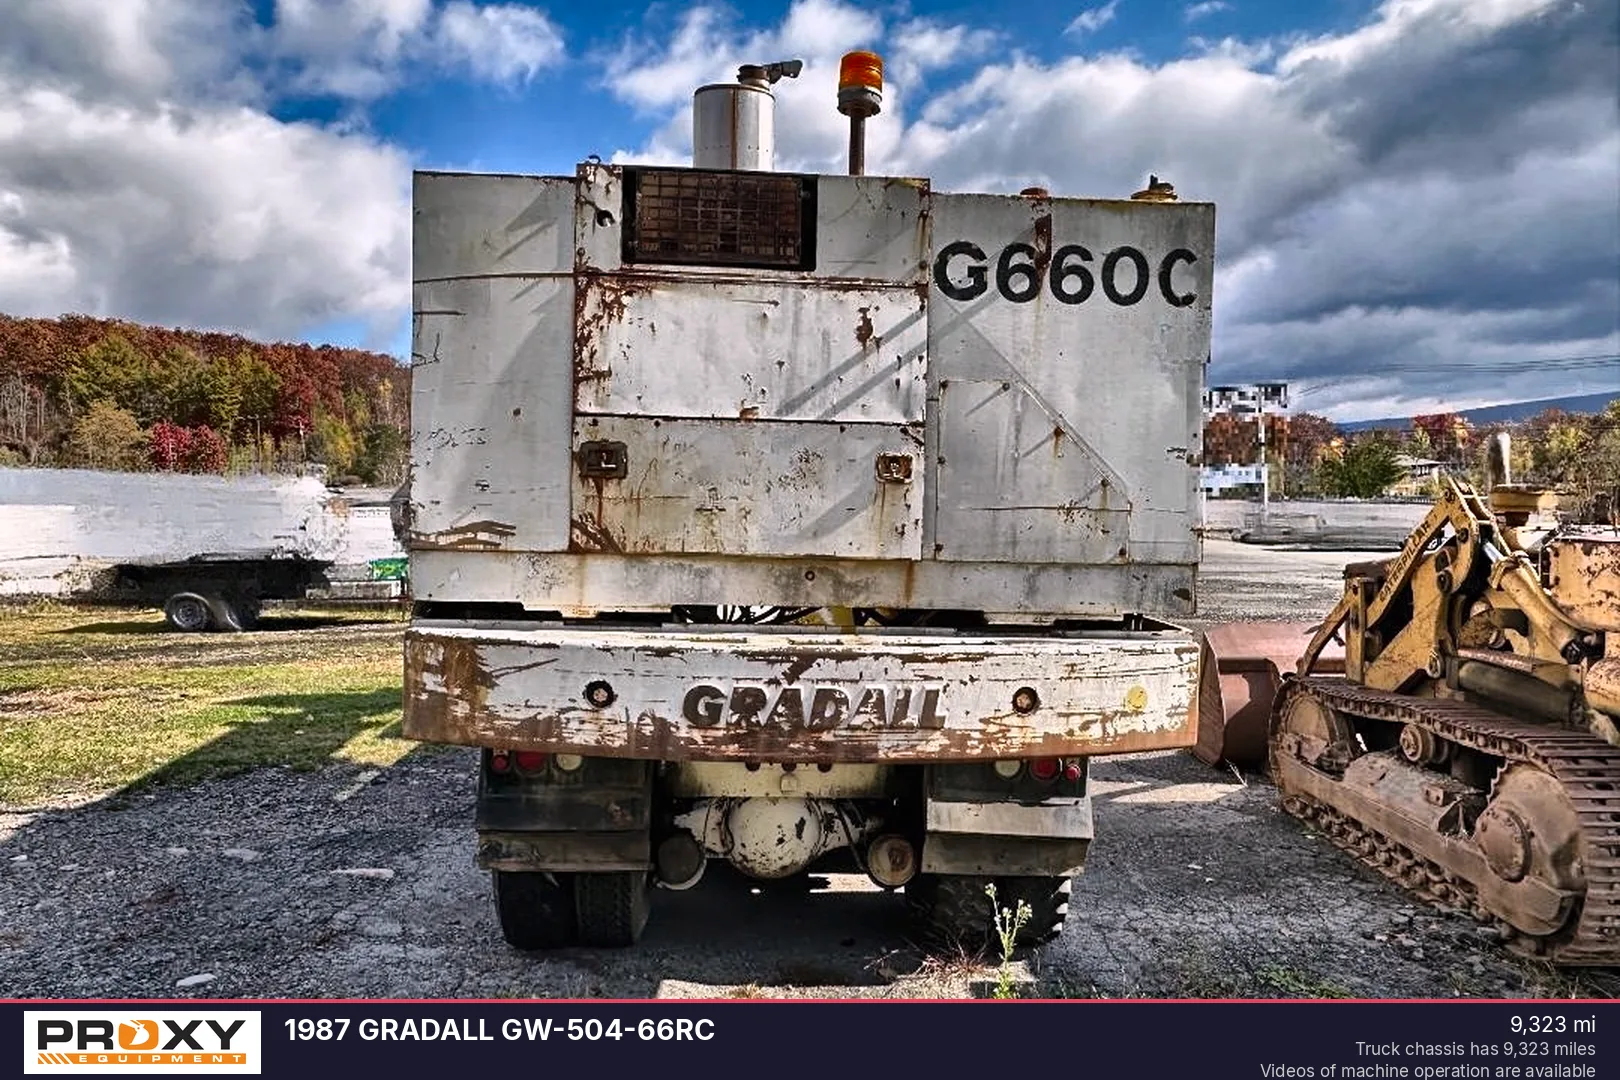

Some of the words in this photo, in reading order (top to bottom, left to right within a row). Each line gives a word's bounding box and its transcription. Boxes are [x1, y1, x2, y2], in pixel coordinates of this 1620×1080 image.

[933, 240, 1198, 307] G660C
[1379, 520, 1431, 602] CATERPILLAR
[682, 684, 948, 729] GRADALL
